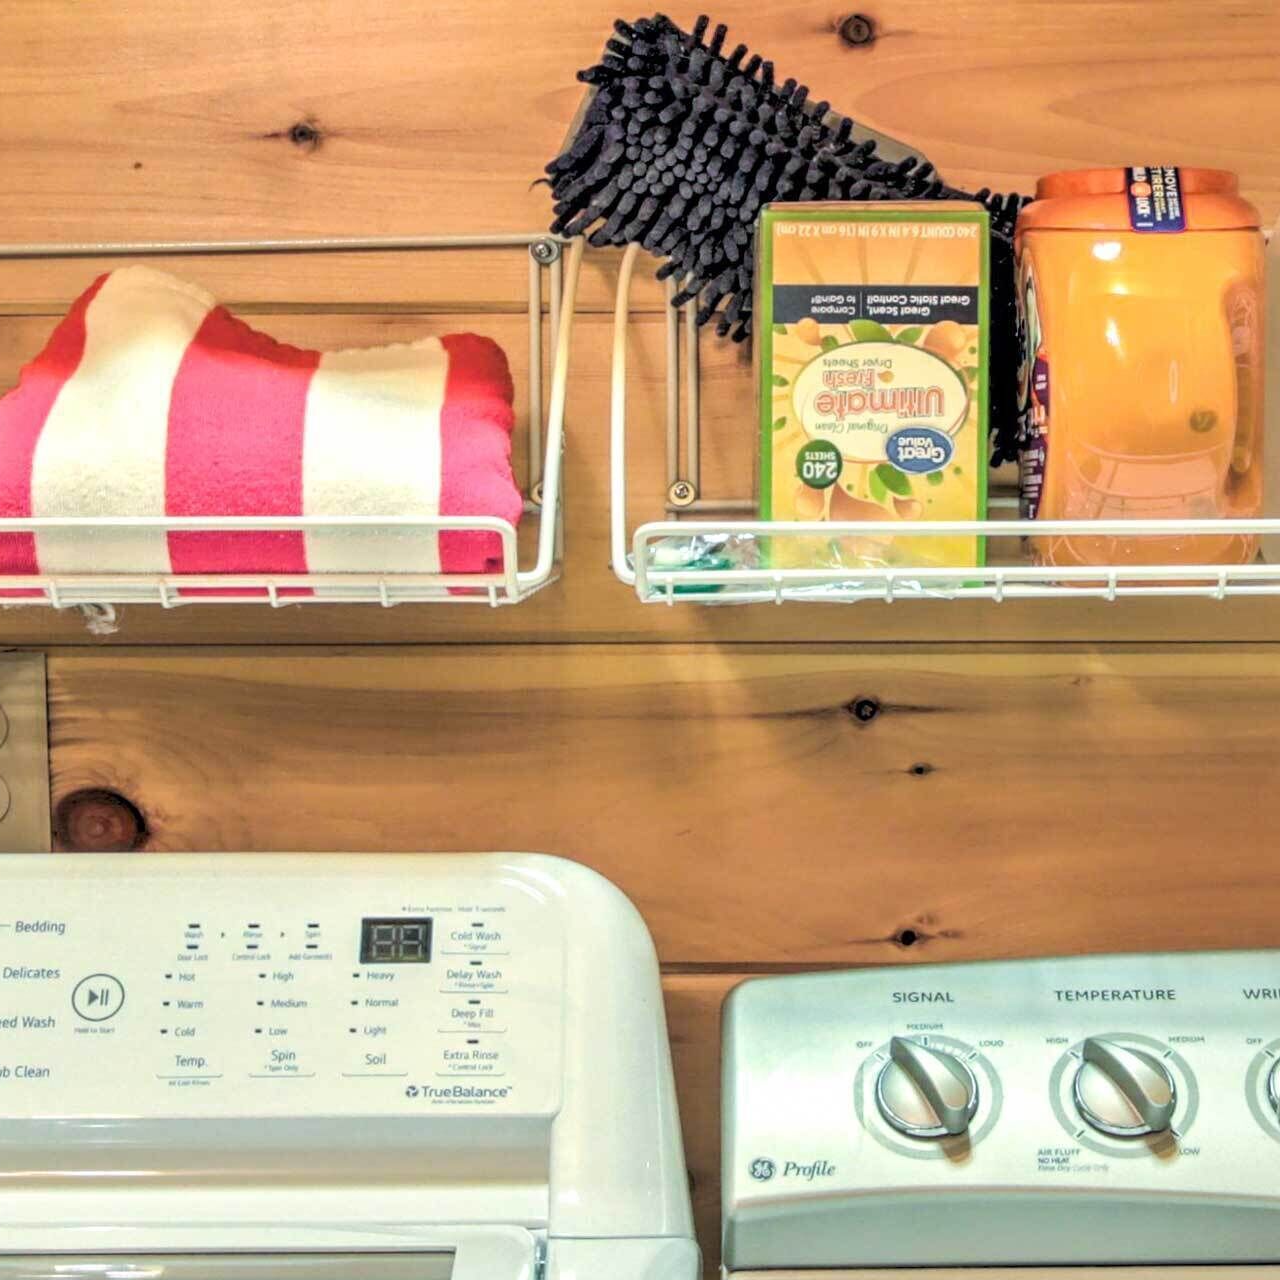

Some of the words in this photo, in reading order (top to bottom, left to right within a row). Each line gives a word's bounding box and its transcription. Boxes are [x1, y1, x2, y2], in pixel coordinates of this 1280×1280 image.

[921, 225, 956, 237] COUNT
[957, 225, 977, 237] 240
[846, 294, 856, 304] to
[910, 294, 939, 305] Static
[941, 294, 970, 305] Great
[811, 305, 856, 316] Compare
[900, 305, 931, 316] Great
[822, 358, 859, 368] Sheets
[862, 358, 893, 368] Dryer
[823, 369, 876, 389] Fresh
[814, 387, 945, 421] Ultimate
[898, 436, 933, 449] Value
[805, 451, 836, 460] SHEETS
[896, 445, 946, 463] Great
[802, 461, 838, 479] 240
[15, 921, 66, 935] Bedding
[450, 931, 474, 941] Cold
[476, 931, 501, 941] Wash
[2, 966, 61, 979] Delicates
[179, 973, 196, 981] Hot
[273, 971, 294, 982] High
[366, 971, 395, 981] Heavy
[446, 970, 475, 980] Delay
[477, 970, 502, 979] Wash
[892, 992, 955, 1003] SIGNAL
[1055, 989, 1177, 1001] TEMPERATURE
[177, 1000, 204, 1009] Warm
[271, 999, 308, 1008] Medium
[365, 998, 398, 1007] Normal
[451, 1009, 476, 1019] Deep
[479, 1009, 494, 1018] Fill
[22, 1016, 56, 1028] Wash
[174, 1027, 196, 1037] Cold
[269, 1027, 288, 1036] Low
[364, 1026, 387, 1035] Light
[271, 1050, 296, 1063] Spin
[365, 1054, 387, 1065] Soil
[443, 1051, 470, 1060] Extra
[472, 1051, 499, 1060] Rinse
[175, 1055, 208, 1068] Temp.
[15, 1066, 50, 1078] Clean
[783, 1160, 836, 1182] Profile
